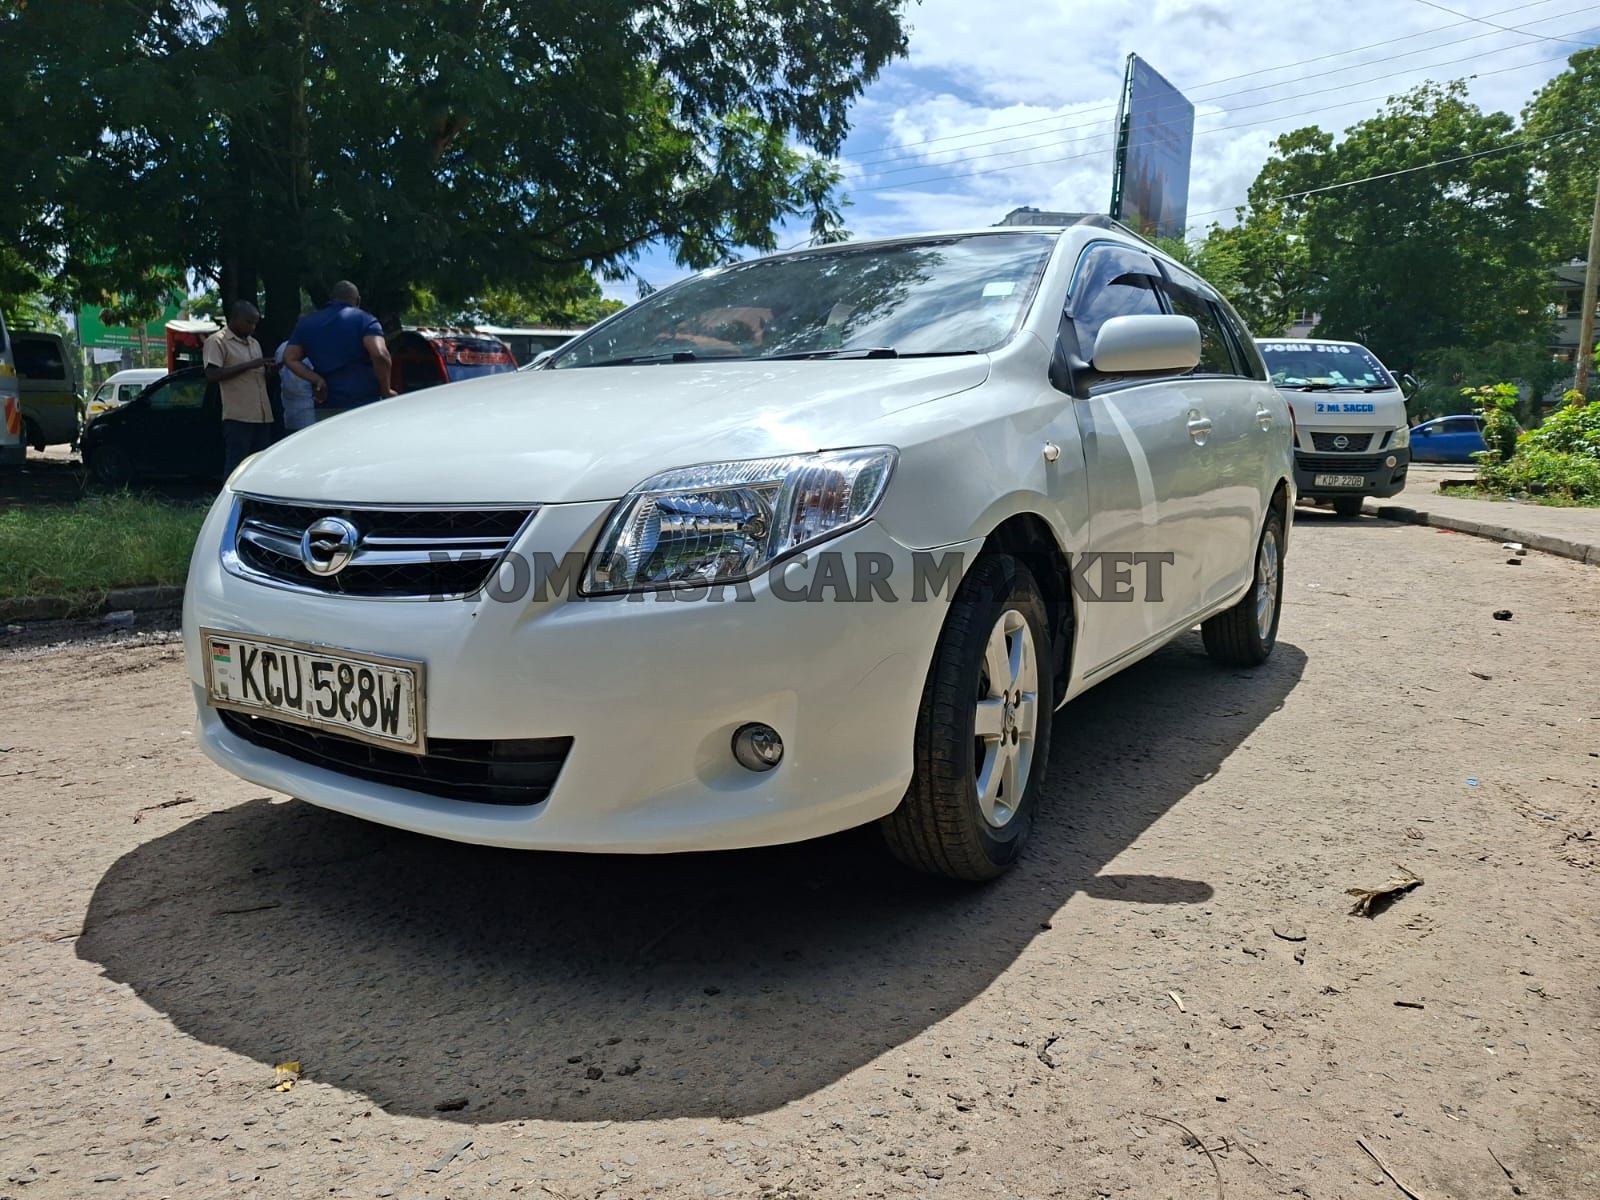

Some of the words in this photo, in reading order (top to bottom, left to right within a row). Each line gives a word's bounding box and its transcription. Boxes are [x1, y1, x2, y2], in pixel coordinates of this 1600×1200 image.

[1264, 344, 1312, 352] JOHN
[1317, 404, 1324, 412] 2
[1343, 404, 1373, 412] SACCO
[239, 645, 303, 711] KCU
